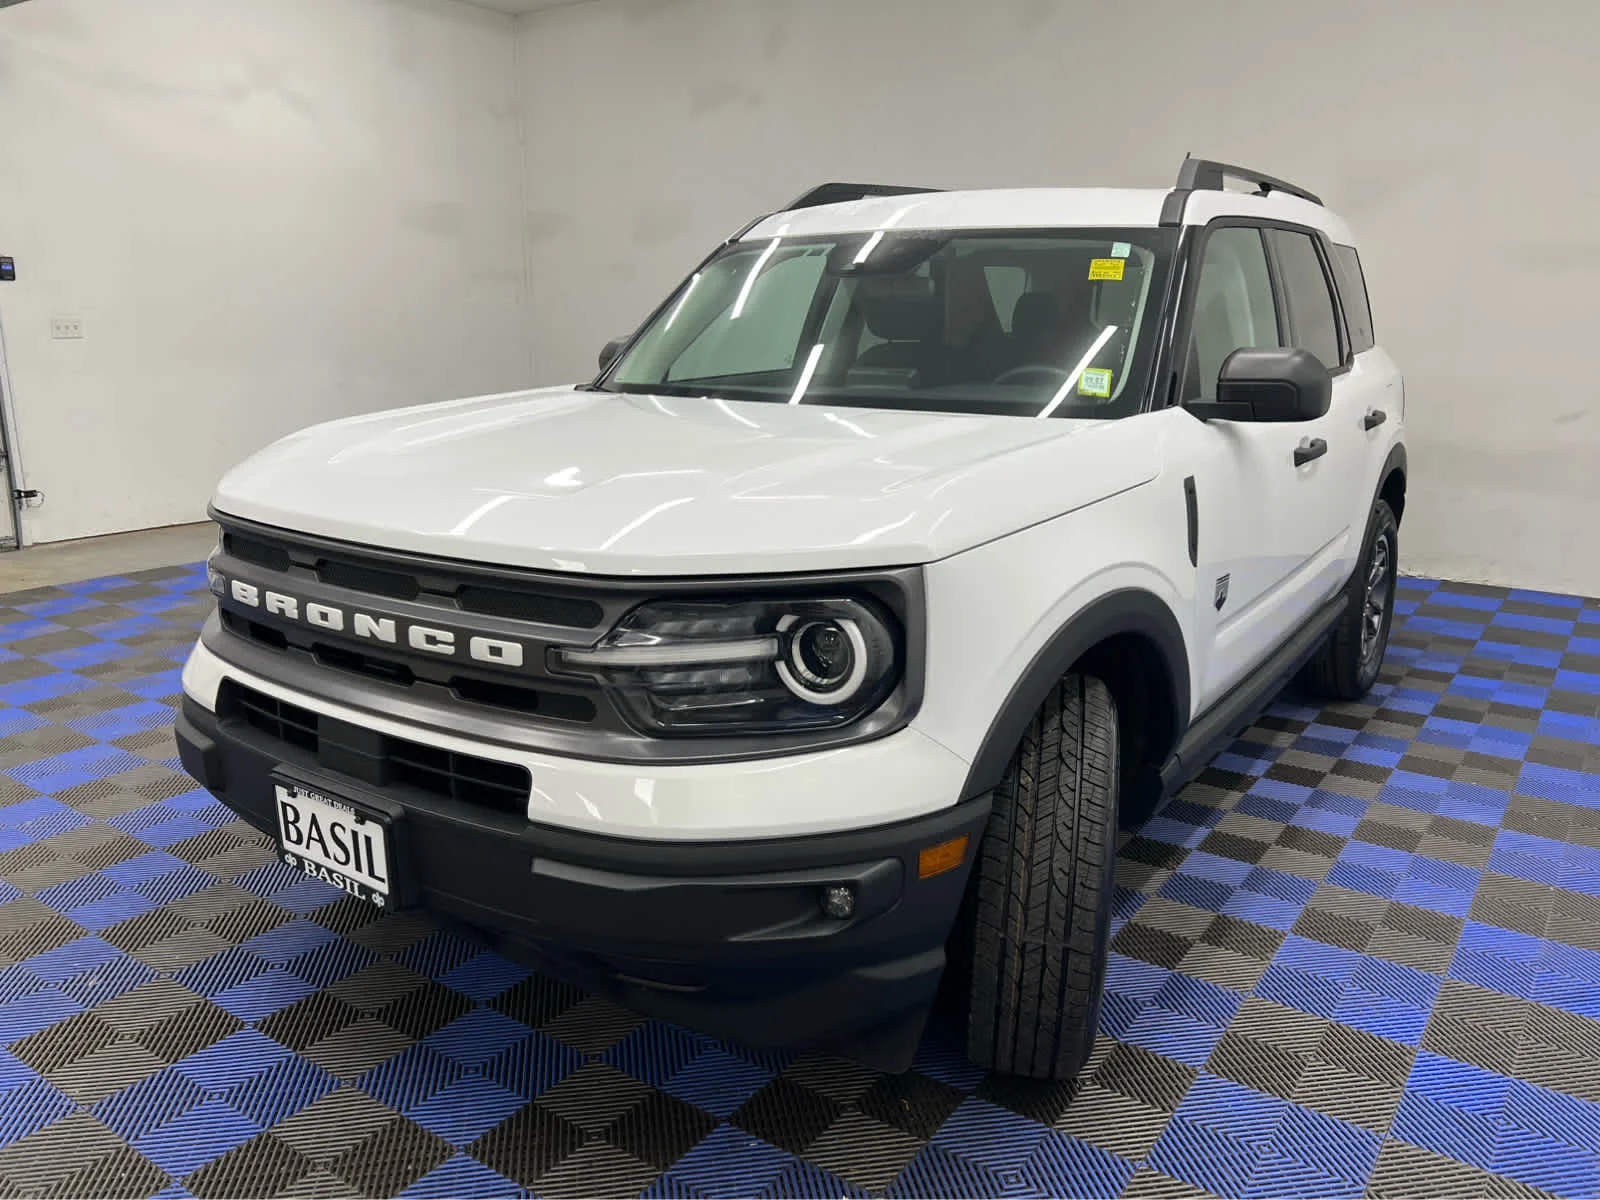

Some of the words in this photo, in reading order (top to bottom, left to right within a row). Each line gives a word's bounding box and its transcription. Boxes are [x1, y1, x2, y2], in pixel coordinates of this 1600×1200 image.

[231, 579, 524, 667] BRONCO
[280, 801, 386, 884] BASIL
[303, 858, 366, 900] BASIL
